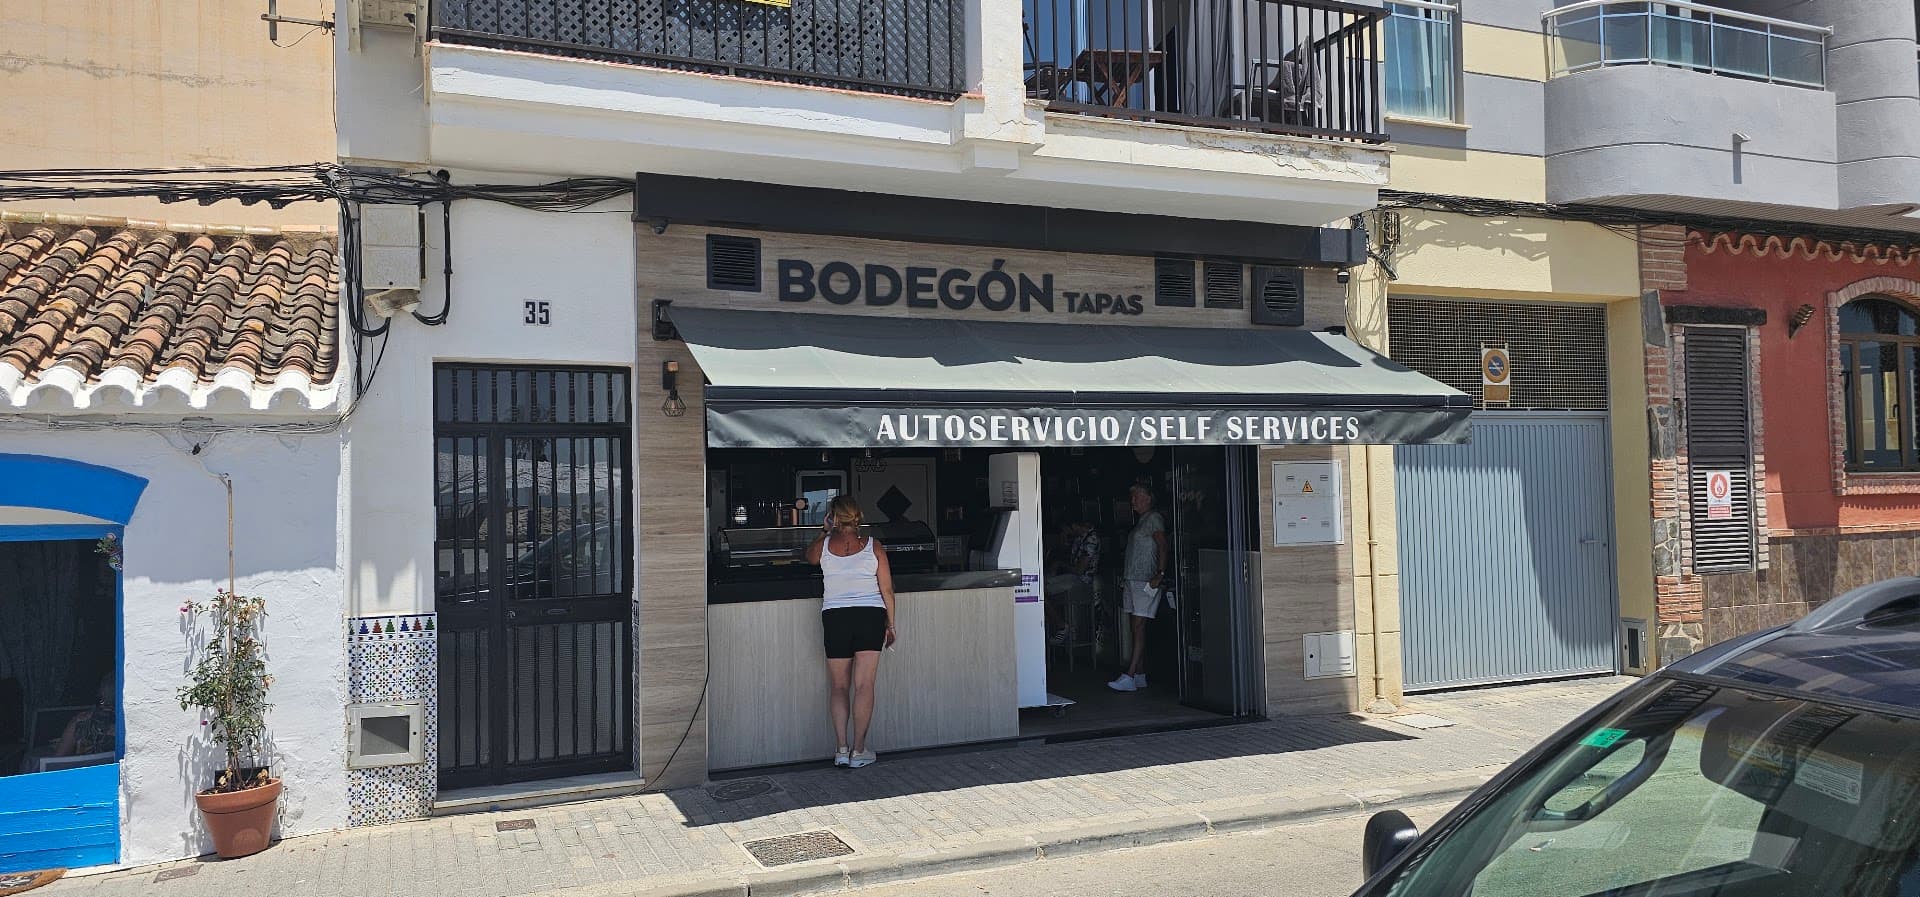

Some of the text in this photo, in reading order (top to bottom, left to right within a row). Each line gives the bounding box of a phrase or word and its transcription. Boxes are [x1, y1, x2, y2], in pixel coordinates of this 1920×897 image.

[777, 258, 1144, 316] BODEGÓN TAPAS
[525, 301, 550, 325] 35
[1226, 416, 1360, 441] SERVICES
